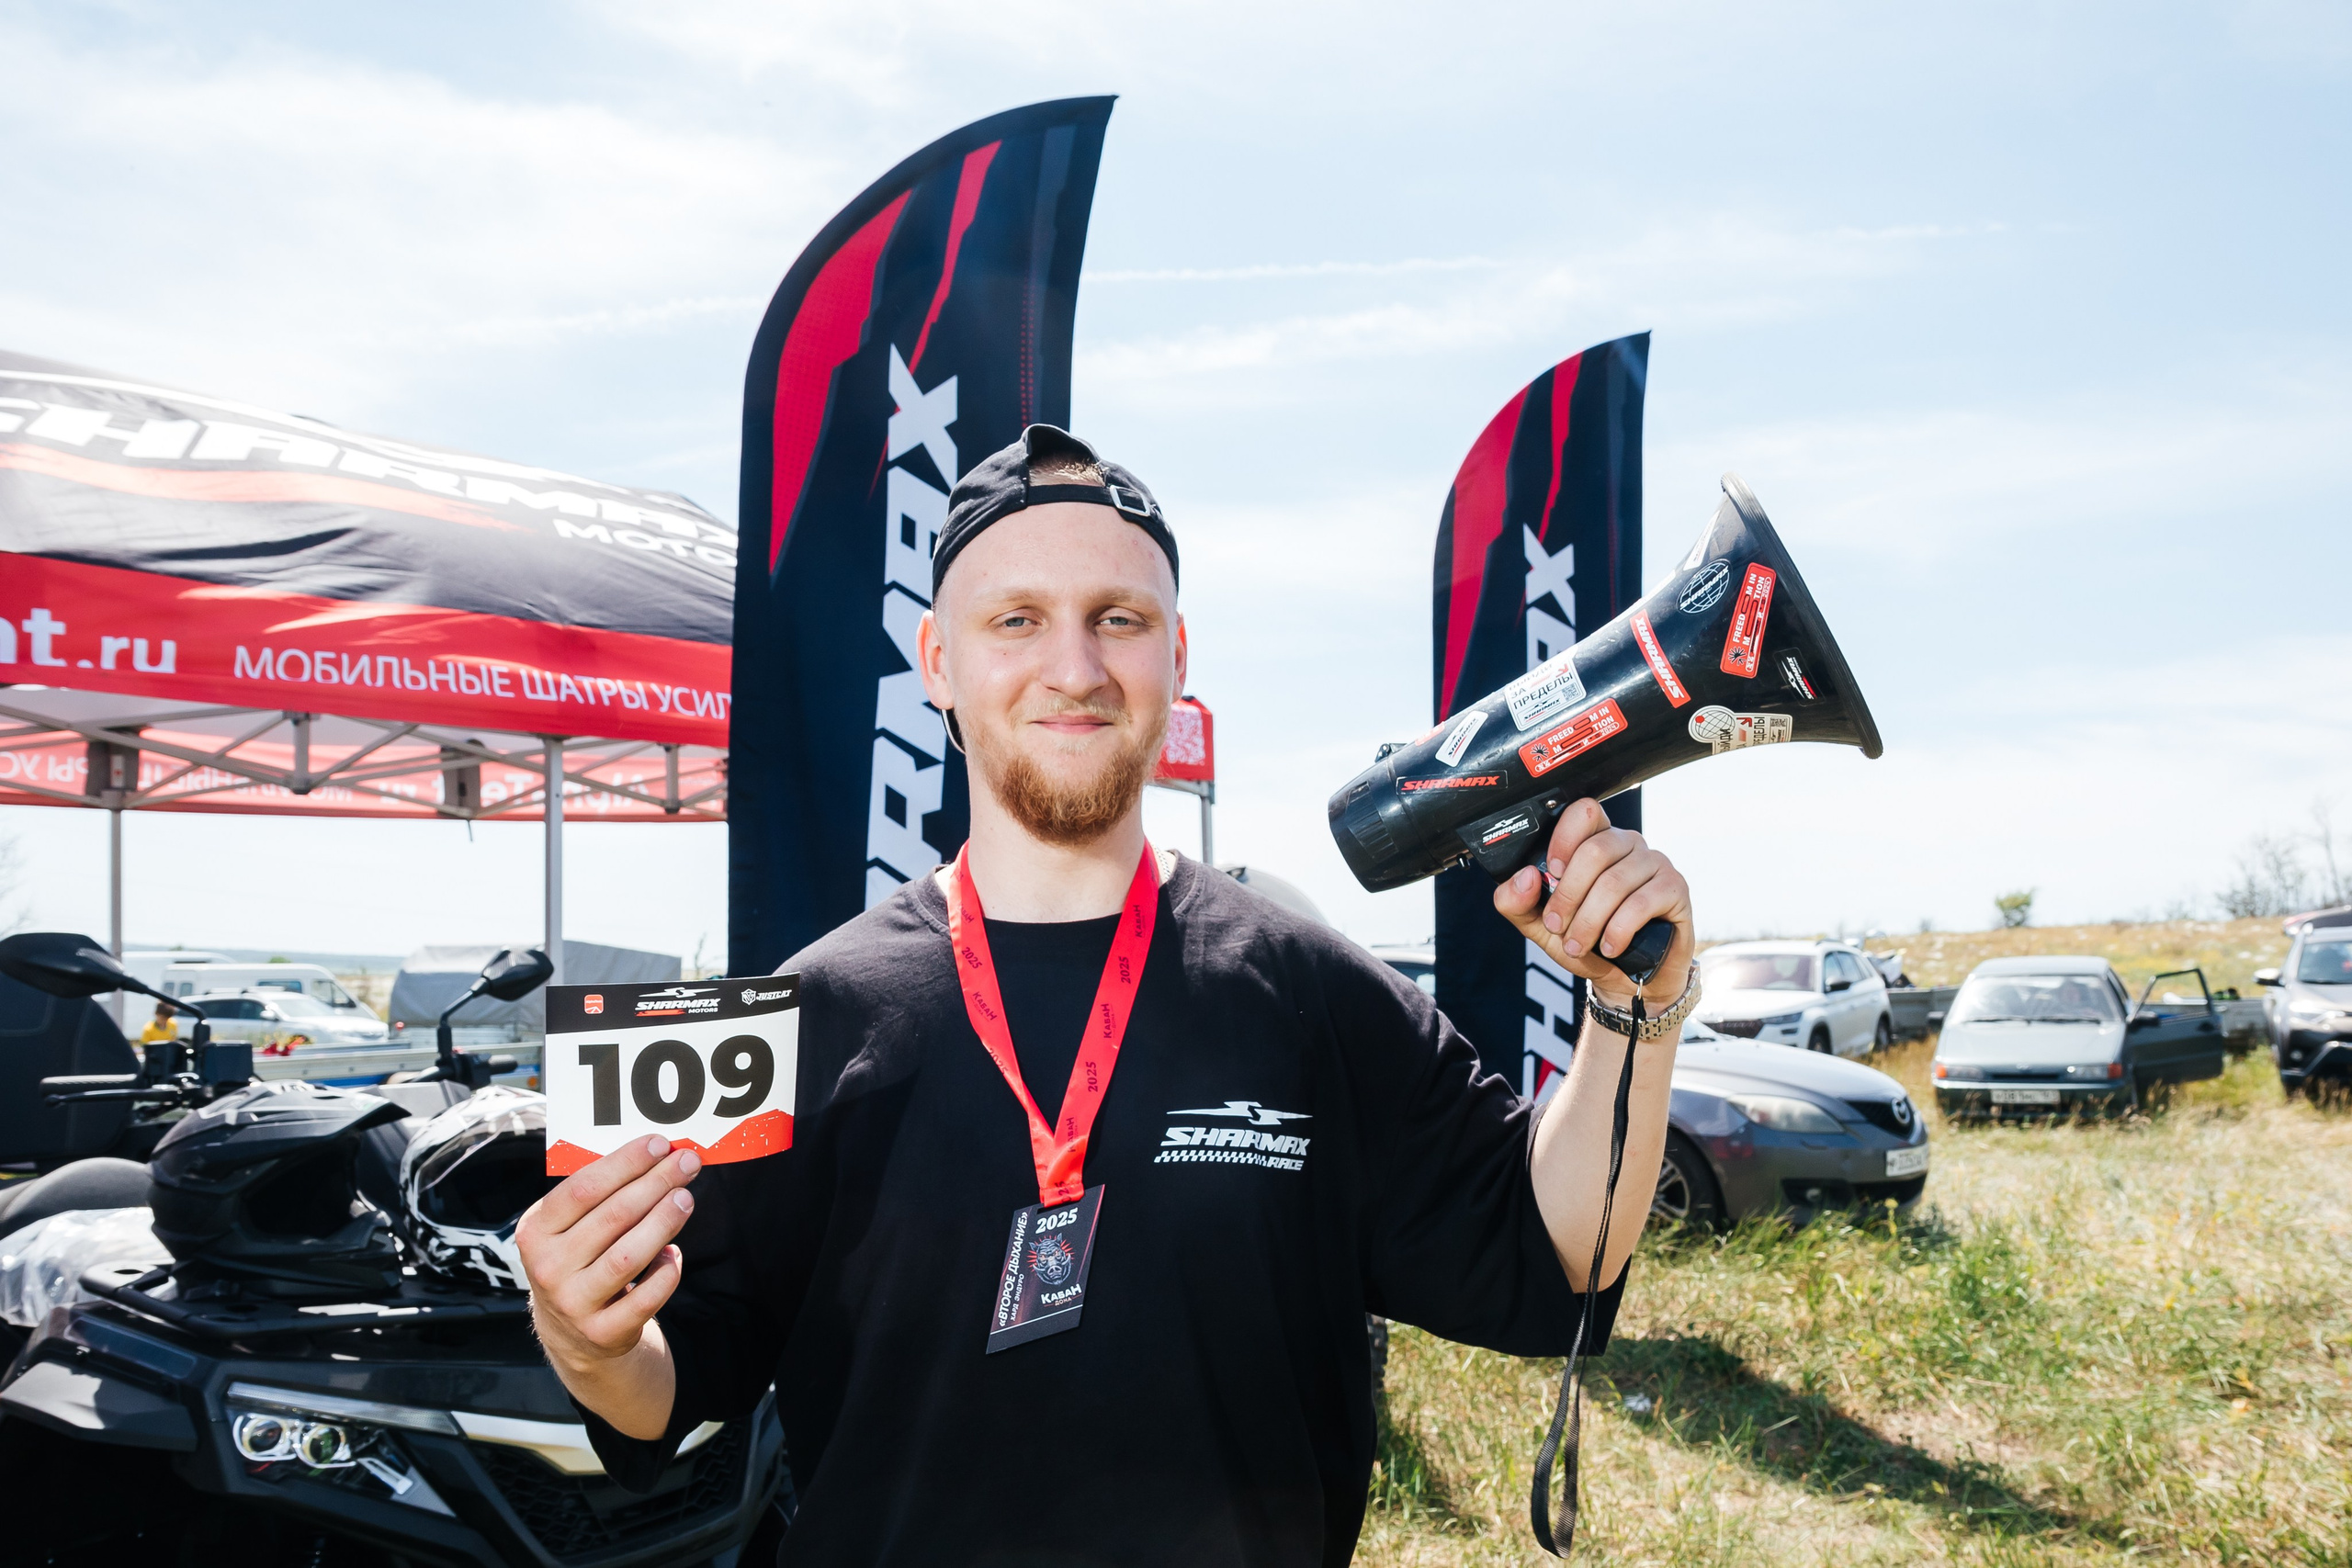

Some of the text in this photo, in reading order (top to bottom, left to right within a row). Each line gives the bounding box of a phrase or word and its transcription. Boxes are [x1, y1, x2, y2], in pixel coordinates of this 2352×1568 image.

[1635, 616, 1685, 698] SHARMAX
[233, 645, 515, 698] МОБИЛЬНЫЕ
[519, 668, 650, 711] ШАТРЫ
[1513, 671, 1573, 709] ПРЕДЕЛЫ
[1401, 775, 1500, 791] SHARMAX
[961, 946, 983, 969] 2025
[1118, 956, 1131, 984] 2025
[635, 998, 721, 1011] SHARMAX
[578, 1033, 775, 1126] 109
[1085, 1061, 1098, 1092] 2025
[1160, 1126, 1311, 1156] SHARMAX
[1266, 1156, 1304, 1171] RACE
[1035, 1207, 1079, 1234] 2025
[998, 1212, 1029, 1327] «ВТОРОЕ ДЫХАНИЕ»
[1010, 1273, 1024, 1321] ХАРД ЭНДУРО
